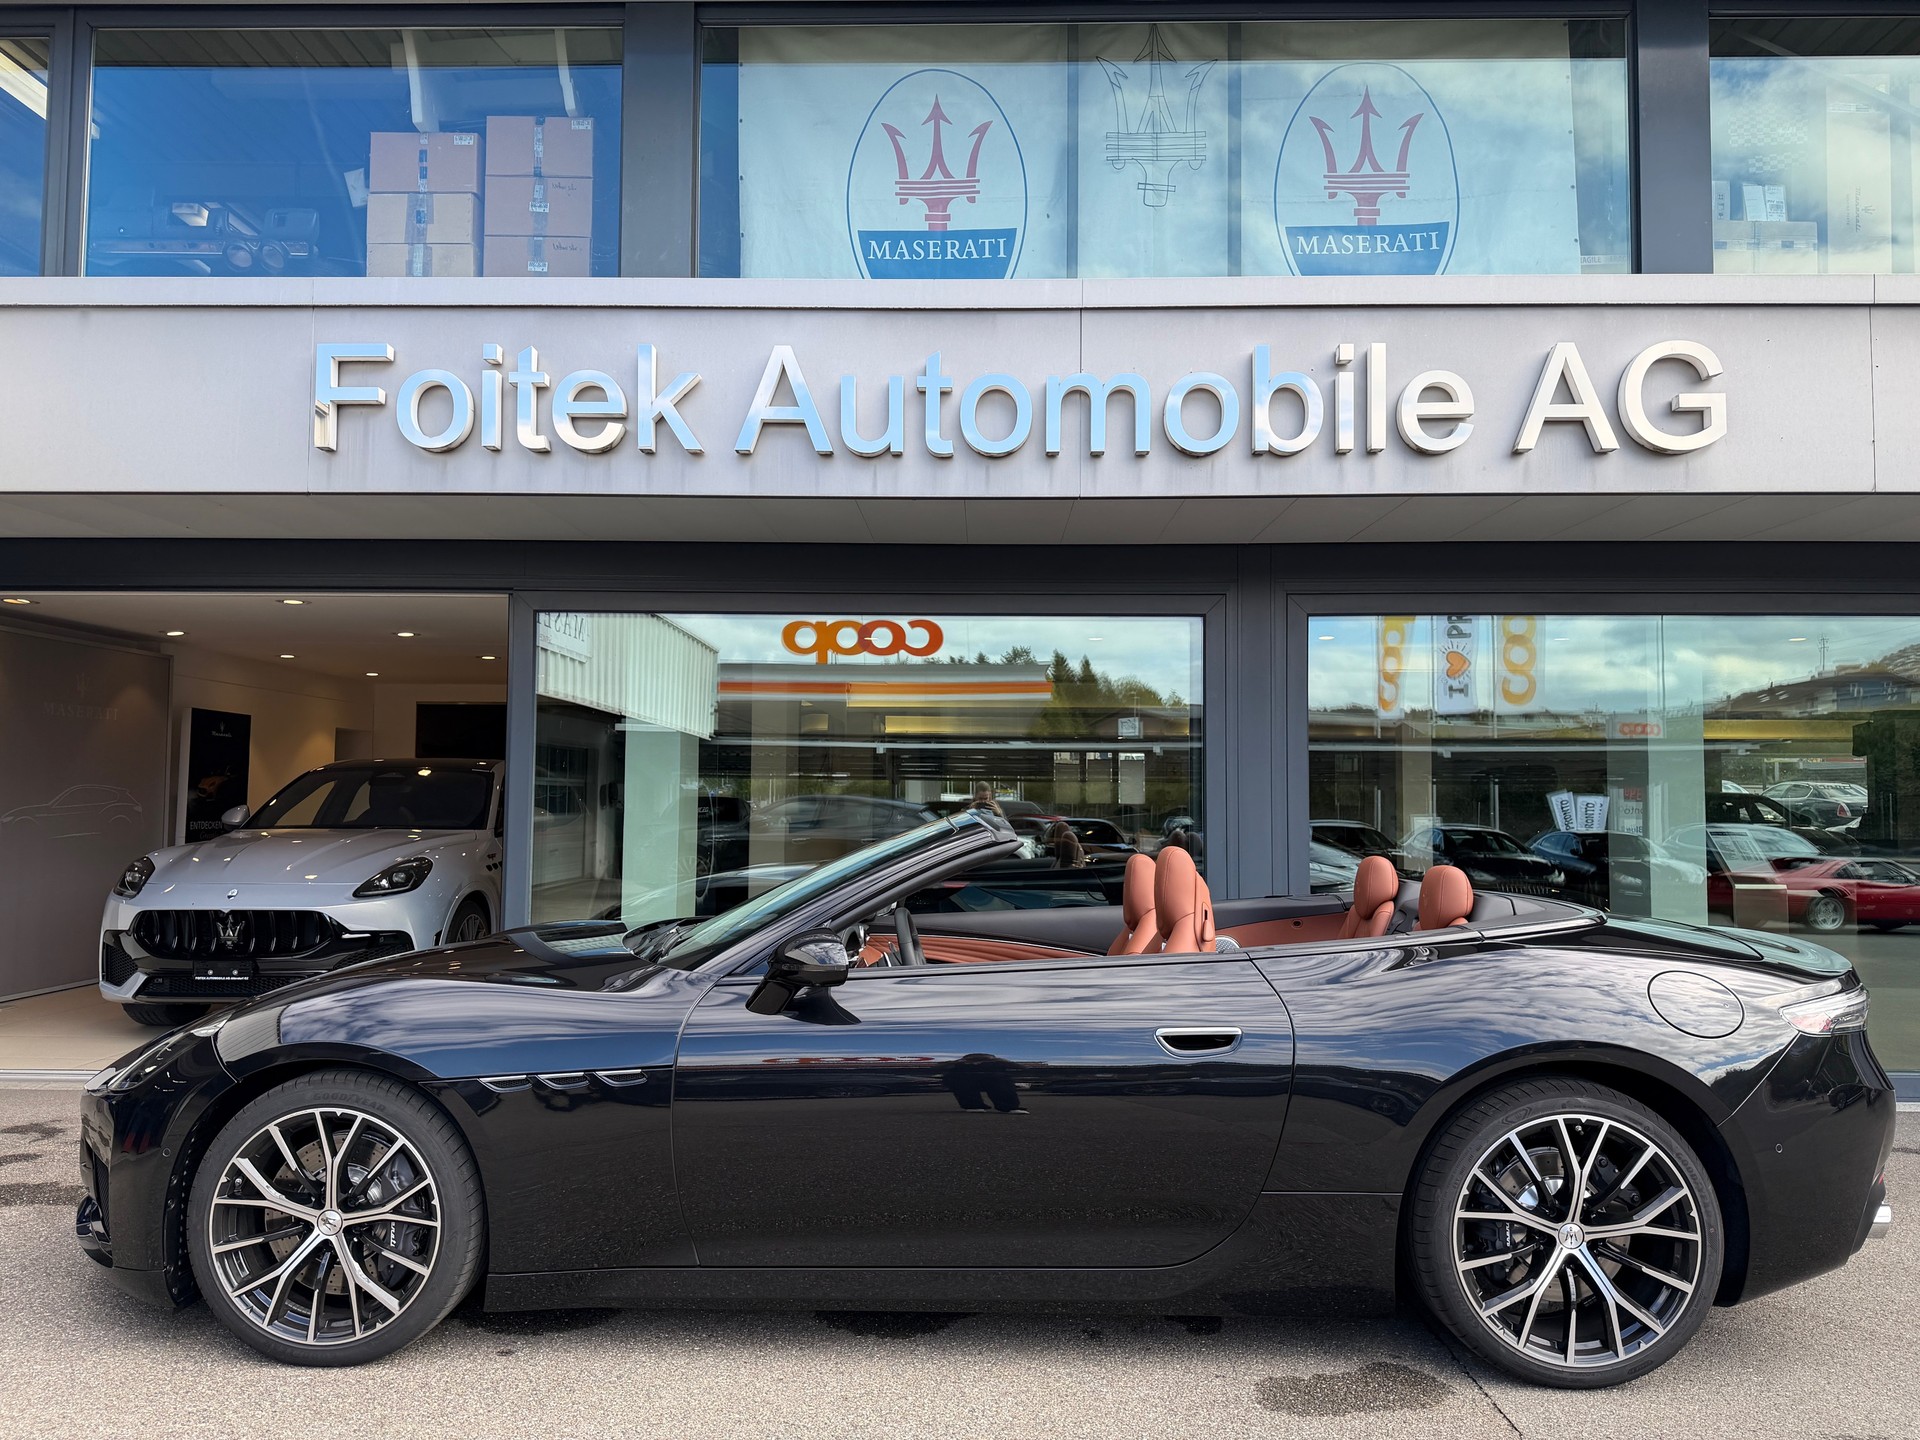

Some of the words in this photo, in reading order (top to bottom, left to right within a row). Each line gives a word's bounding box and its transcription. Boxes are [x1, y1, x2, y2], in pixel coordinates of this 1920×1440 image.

[868, 238, 1007, 260] MASERATI
[1296, 232, 1440, 255] MASERATI
[313, 342, 704, 455] Foitek
[734, 343, 1476, 456] Automobile
[1511, 339, 1728, 456] AG
[1560, 799, 1575, 831] PRONTO
[1584, 802, 1595, 830] RONTO
